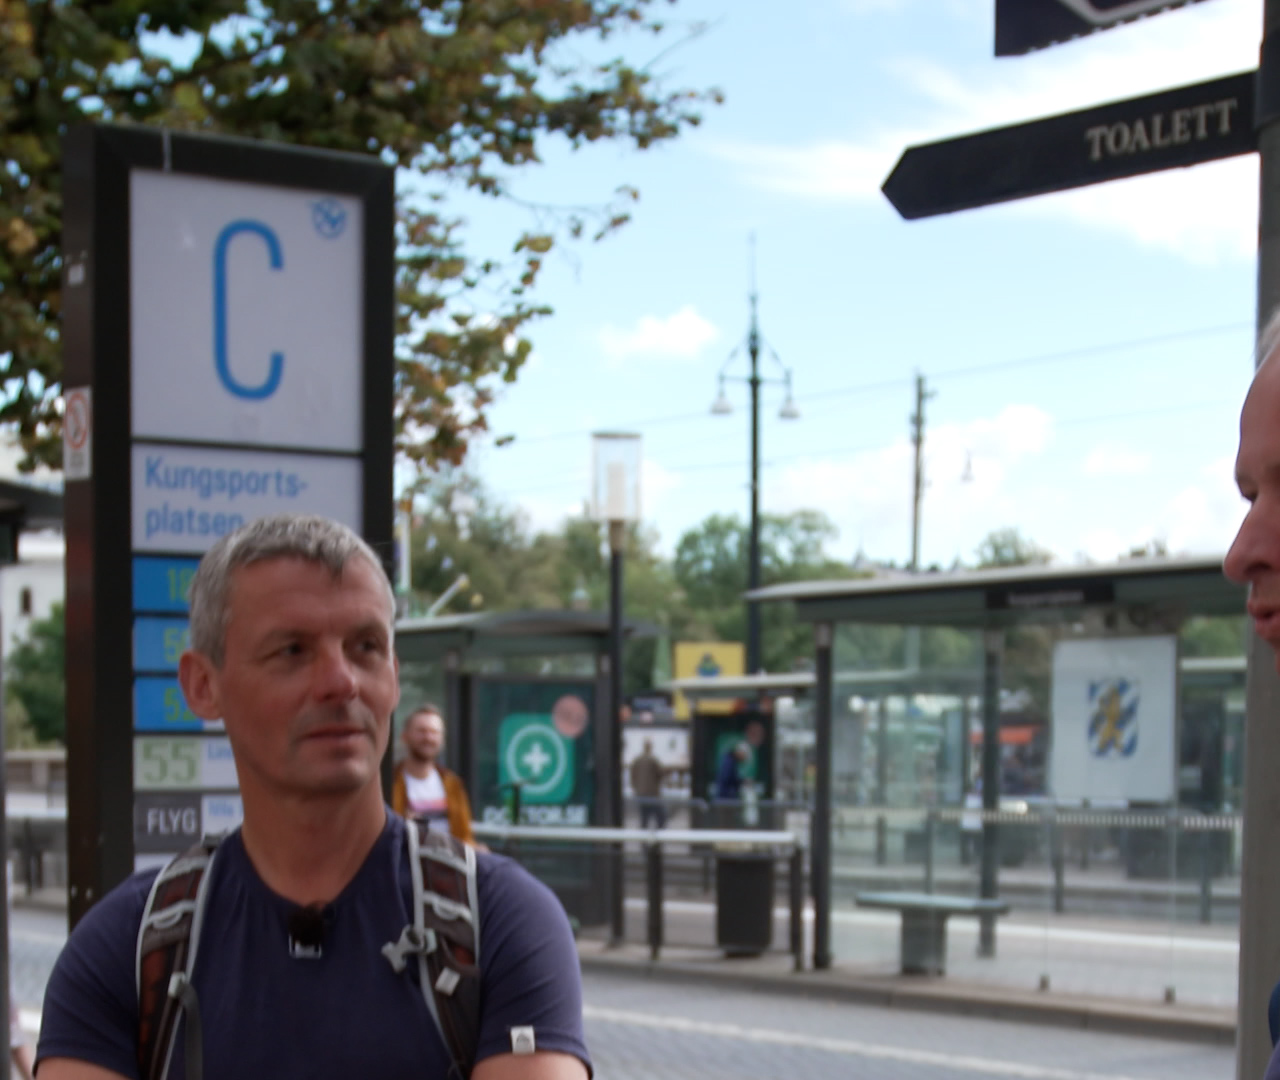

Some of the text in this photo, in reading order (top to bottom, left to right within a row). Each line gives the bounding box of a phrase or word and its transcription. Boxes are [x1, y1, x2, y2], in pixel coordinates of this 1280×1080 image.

[1085, 97, 1238, 161] TOALETT
[213, 217, 284, 401] C
[144, 455, 310, 501] Kungsports-
[142, 739, 197, 783] 55
[146, 807, 197, 835] FLYG
